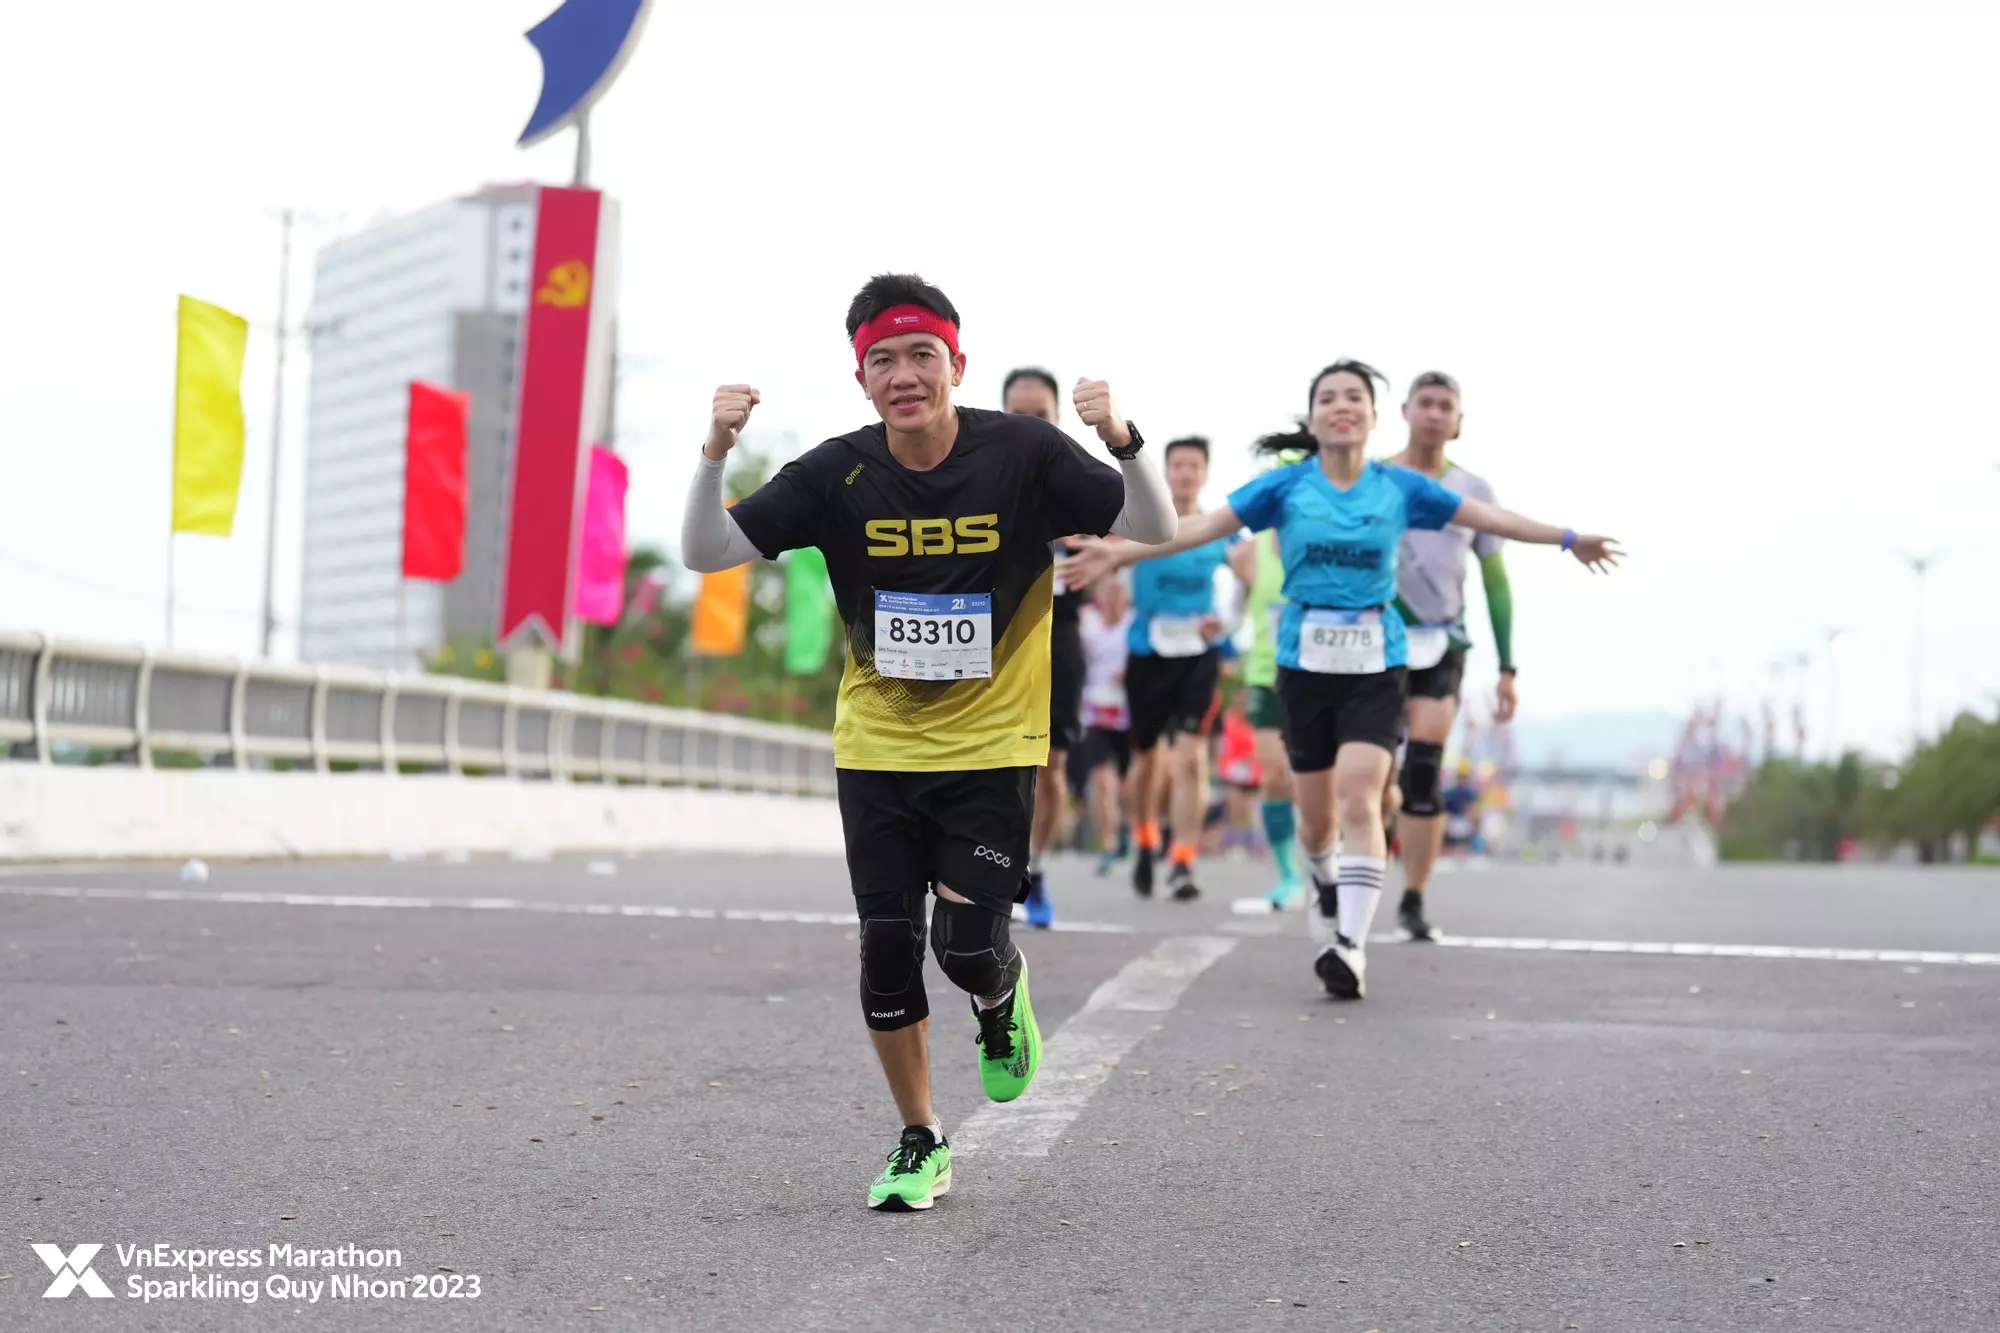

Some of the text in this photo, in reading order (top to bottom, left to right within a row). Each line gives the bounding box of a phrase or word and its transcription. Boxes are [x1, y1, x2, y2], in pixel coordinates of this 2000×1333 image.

[865, 513, 1000, 557] SBS
[890, 617, 976, 645] 83310
[1313, 627, 1372, 647] 82778
[870, 1008, 906, 1018] AONIJIE
